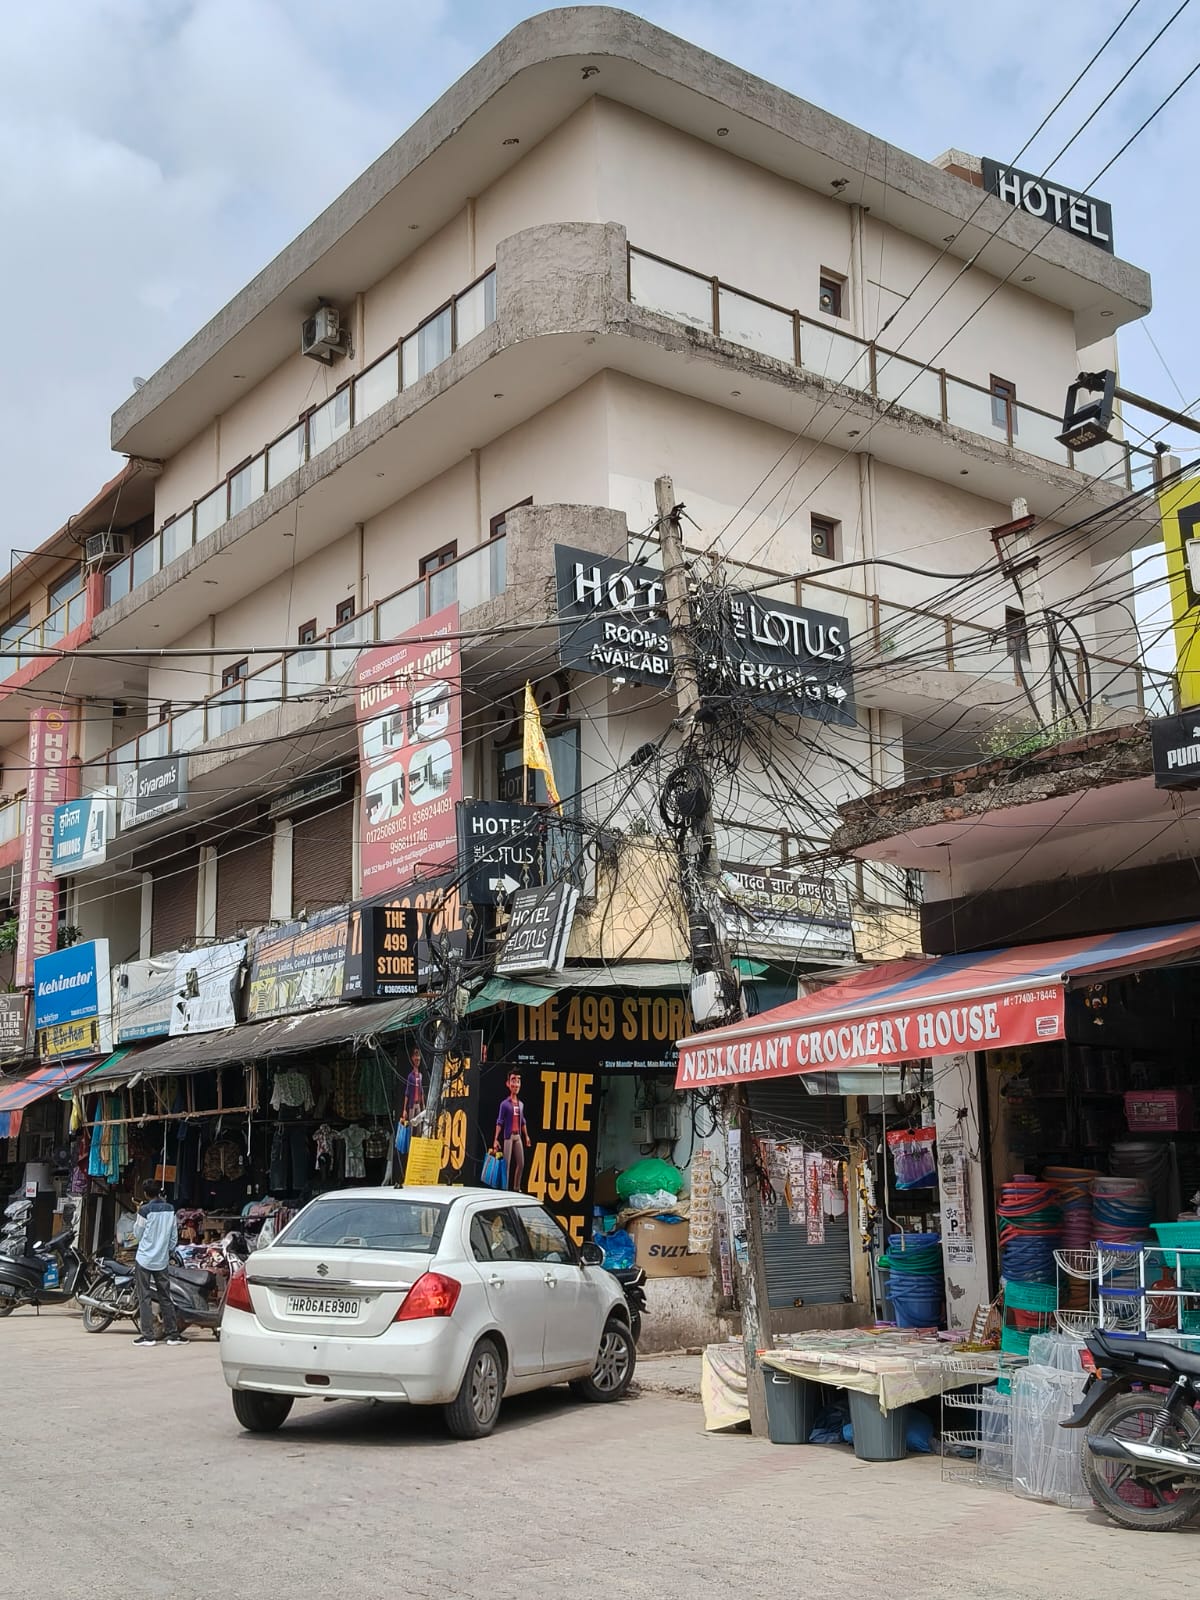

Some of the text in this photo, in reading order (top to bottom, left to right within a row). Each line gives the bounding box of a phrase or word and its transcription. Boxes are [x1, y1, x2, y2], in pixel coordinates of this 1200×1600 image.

[997, 169, 1109, 241] HOTEL
[575, 562, 664, 615] HOT
[605, 622, 668, 652] ROOMS
[731, 601, 846, 662] THE LOTUS
[590, 644, 672, 675] AVAILABL
[360, 675, 393, 711] HOTEL
[395, 662, 415, 693] THE
[417, 641, 453, 680] LOTUS
[43, 733, 63, 806] HOTEL
[139, 765, 177, 797] Siyaram's
[501, 776, 534, 800] HOTL
[483, 846, 534, 865] LOTUS
[33, 889, 54, 955] BROOKS
[384, 911, 406, 929] THE
[511, 906, 551, 928] HOTEL
[383, 933, 408, 952] 499
[514, 928, 548, 951] LOTUS
[322, 953, 338, 963] Wears
[377, 956, 415, 975] STORE
[38, 970, 93, 997] Kelvinator
[0, 1011, 24, 1021] TEL
[518, 997, 559, 1041] THE
[566, 996, 615, 1041] 499
[682, 1002, 1000, 1082] NEELKHANT CROCKERY HOUSE
[540, 1070, 594, 1132] THE
[527, 1142, 589, 1203] 499
[292, 1298, 358, 1315] HR06AE8900
